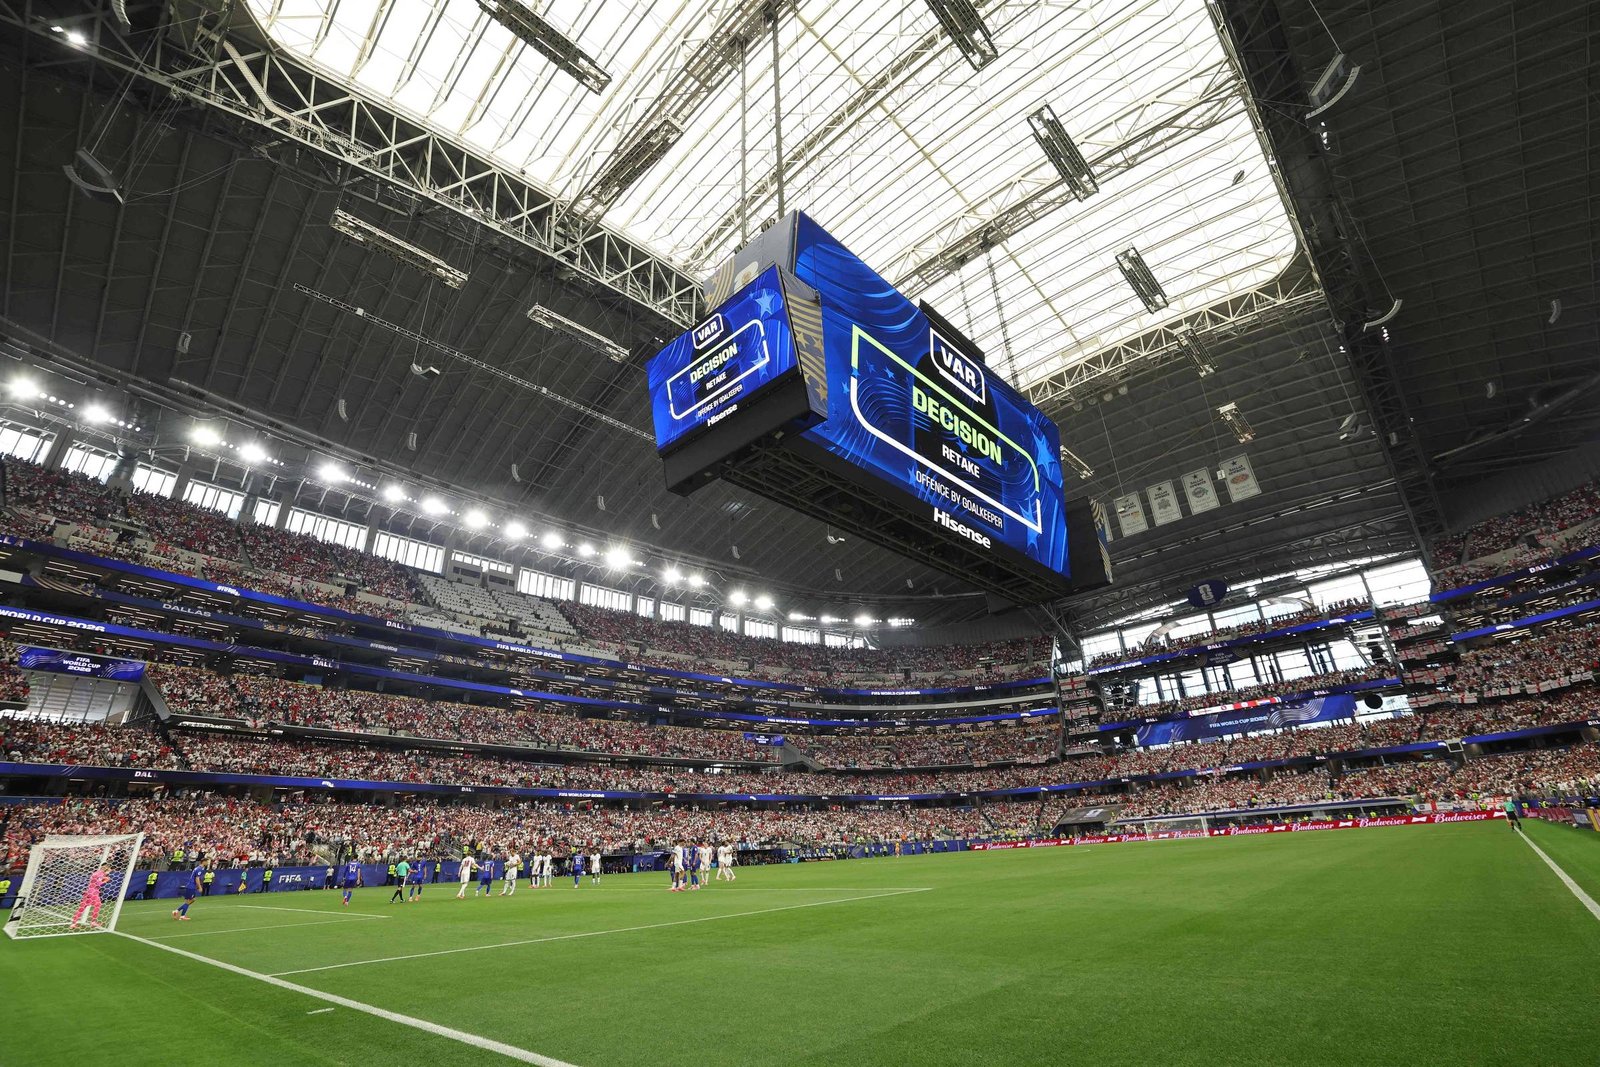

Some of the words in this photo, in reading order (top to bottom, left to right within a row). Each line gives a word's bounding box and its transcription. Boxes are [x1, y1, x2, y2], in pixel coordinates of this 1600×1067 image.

[697, 320, 718, 341] VAR
[689, 343, 738, 384] DECISION
[940, 345, 977, 389] VAR
[705, 371, 727, 391] RETAKE
[697, 404, 713, 418] OFFENCE
[712, 400, 719, 408] BY
[718, 384, 744, 406] GOALKEEPER
[707, 403, 738, 427] Hisense
[912, 385, 1003, 466] DECISION
[942, 443, 981, 479] RETAKE
[915, 469, 950, 499] OFFENCE
[950, 492, 962, 505] BY
[961, 495, 1003, 529] GOALKEEPER
[933, 507, 992, 549] Hisense
[1538, 580, 1578, 594] DALLAS
[162, 603, 212, 617] DALLAS
[42, 617, 67, 626] CUP
[67, 621, 106, 632] 2026
[496, 643, 510, 651] FIFA
[510, 646, 531, 655] WORLD
[63, 659, 87, 667] WORLD
[67, 665, 92, 673] 2026
[1356, 817, 1407, 828] Budweiser
[1431, 813, 1488, 823] Budweiser
[1228, 826, 1270, 836] Budweiser
[1289, 822, 1335, 832] Budweiser
[985, 842, 1014, 850] Budweiser
[1029, 840, 1058, 848] Budweiser
[1073, 836, 1104, 845] Budweiser
[279, 874, 302, 883] FIFA
